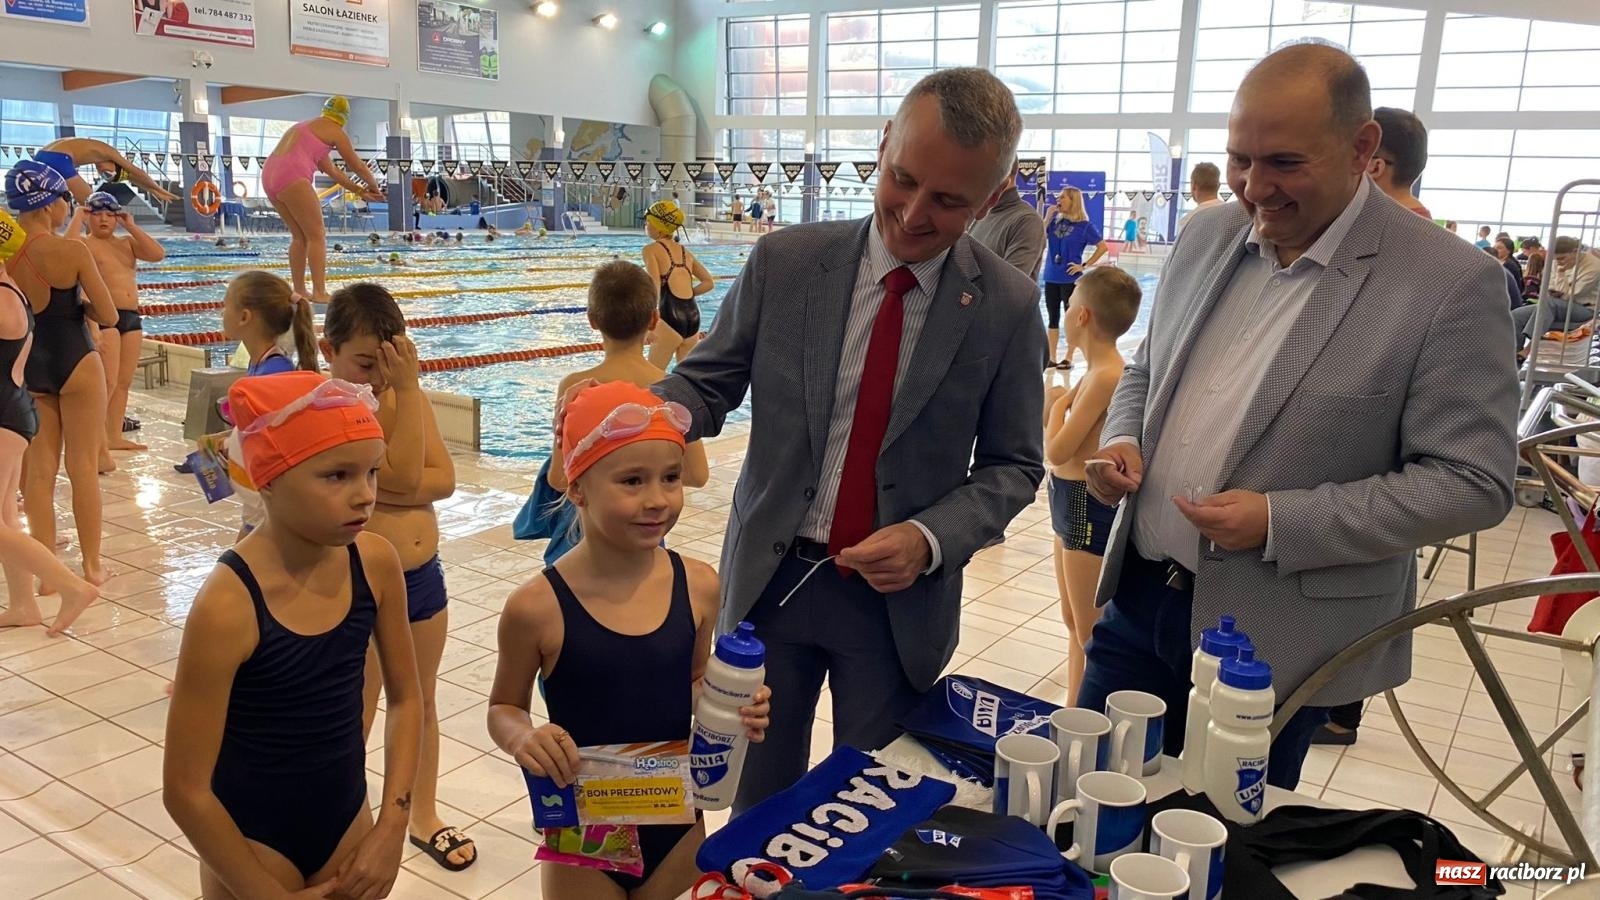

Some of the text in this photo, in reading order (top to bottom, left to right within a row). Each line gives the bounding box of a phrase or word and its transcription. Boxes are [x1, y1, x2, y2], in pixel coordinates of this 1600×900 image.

[194, 7, 253, 22] tel. 784 487 332
[302, 3, 378, 23] SALON ŁAZIENEK
[976, 696, 995, 728] UNIA
[690, 754, 725, 766] UNIA
[587, 786, 679, 798] BON PREZENTOWY
[1239, 781, 1265, 801] UNI
